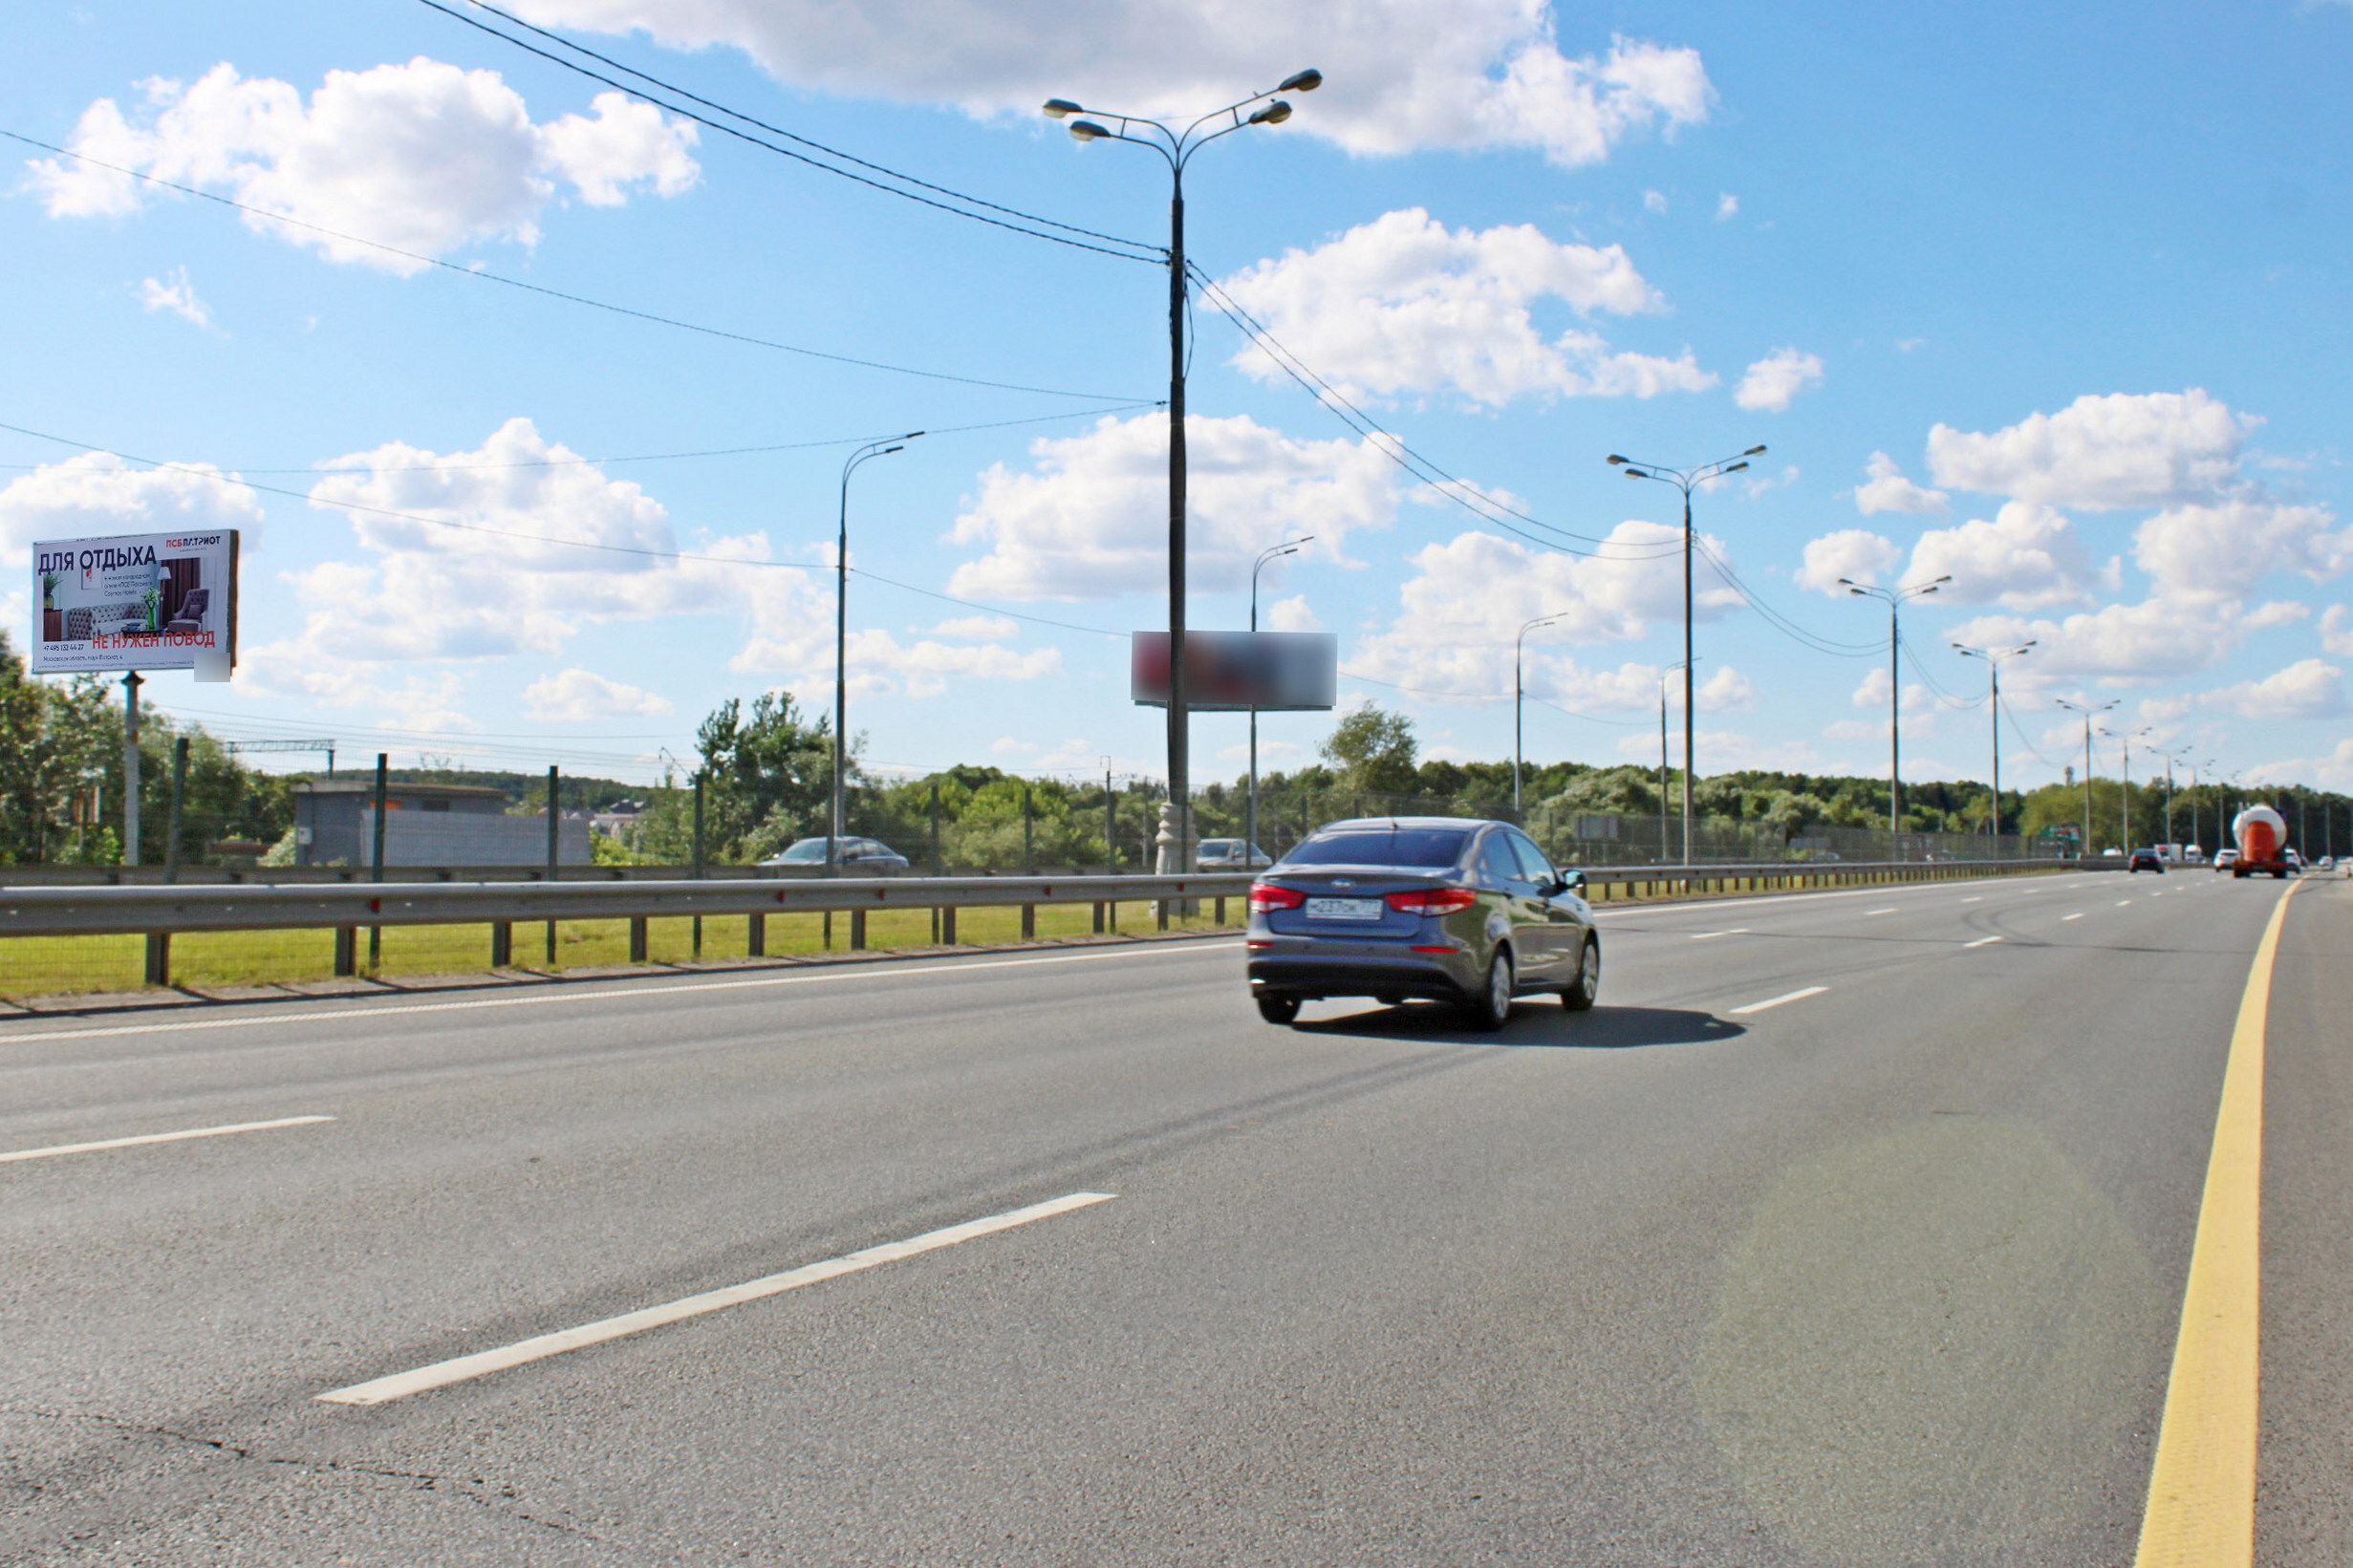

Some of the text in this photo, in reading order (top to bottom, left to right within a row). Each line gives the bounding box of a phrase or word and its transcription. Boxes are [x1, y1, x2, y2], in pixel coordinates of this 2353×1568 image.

[38, 545, 157, 576] ДЛЯ ОТДЫХА
[92, 630, 215, 650] НЕ НУЖЕН ПОВОД
